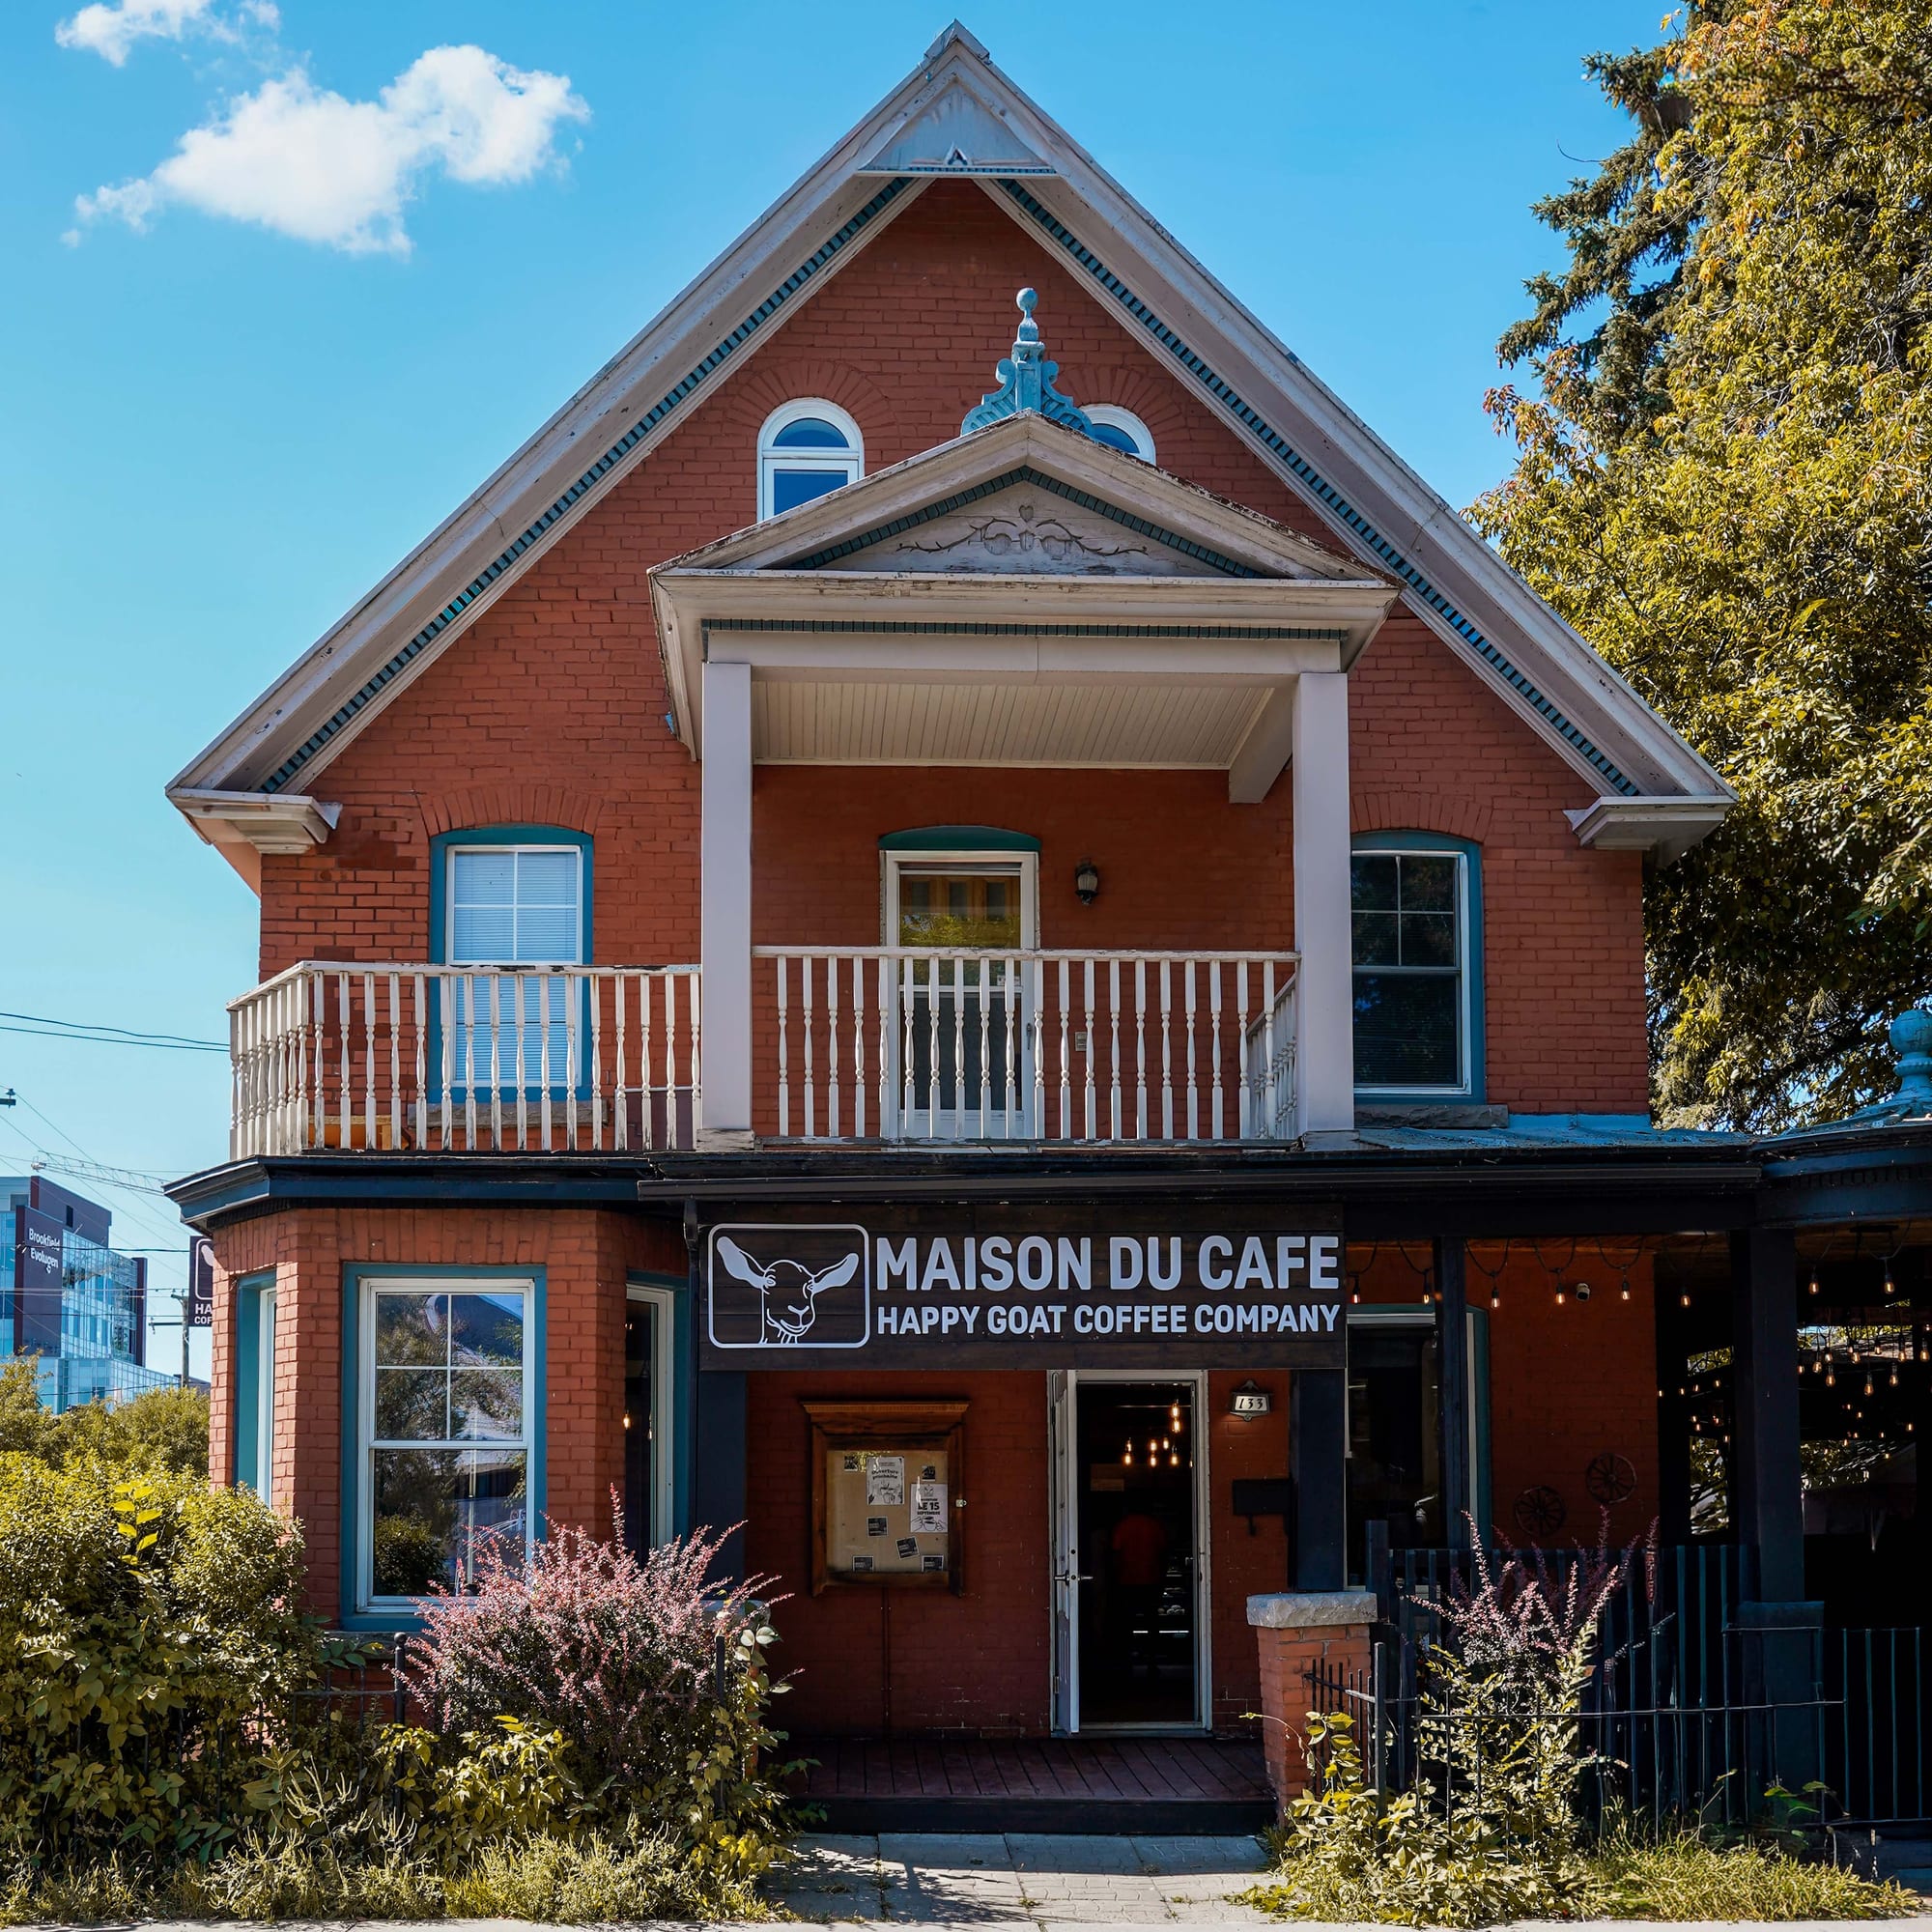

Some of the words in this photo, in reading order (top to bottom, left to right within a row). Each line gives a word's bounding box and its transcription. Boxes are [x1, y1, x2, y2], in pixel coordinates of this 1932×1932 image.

[29, 1227, 61, 1251] Brookfield
[30, 1247, 59, 1274] Evolugen
[877, 1236, 1091, 1291] MAISON
[1110, 1237, 1180, 1290] DU
[1199, 1236, 1338, 1290] CAFE
[878, 1306, 980, 1334] HAPPY
[988, 1306, 1066, 1334] GOAT
[1074, 1305, 1186, 1333] COFFEE
[1195, 1305, 1340, 1332] COMPANY
[1238, 1398, 1264, 1409] 133
[918, 1502, 928, 1511] LE
[929, 1502, 940, 1511] 15
